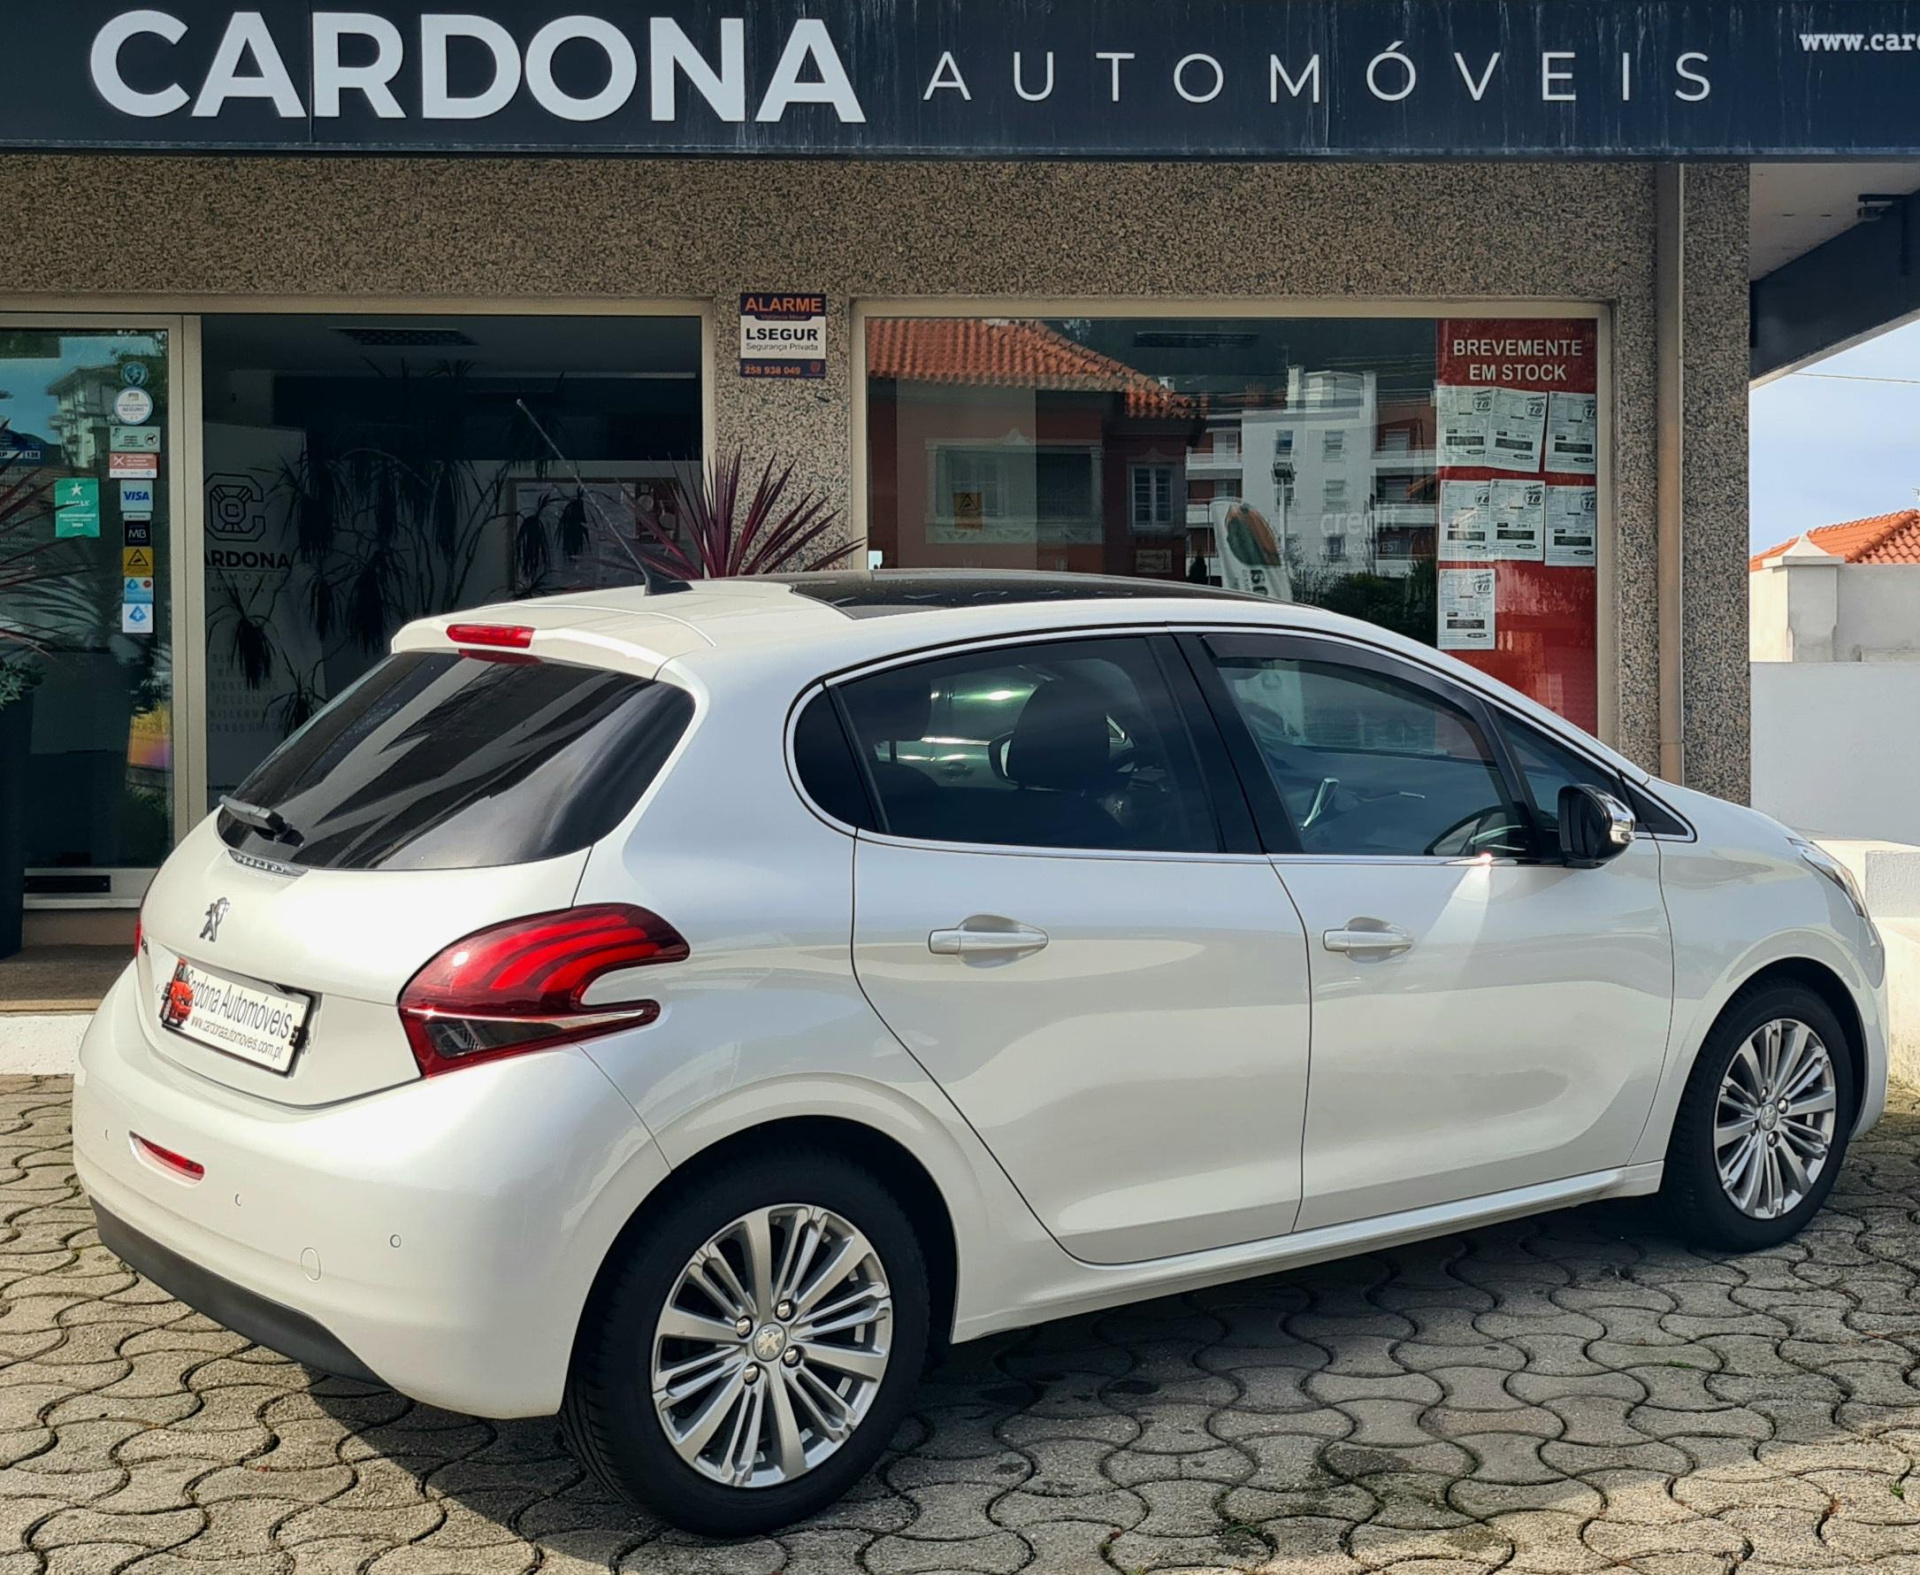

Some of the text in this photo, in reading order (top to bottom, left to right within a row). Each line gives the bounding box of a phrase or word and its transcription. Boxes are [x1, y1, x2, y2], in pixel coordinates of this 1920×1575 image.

[1799, 33, 1920, 52] www.car
[90, 9, 1712, 124] CARDONA AUTOMÓVEIS
[745, 297, 822, 313] ALARME
[746, 327, 819, 341] LSEGUR
[746, 342, 819, 352] Segurança Privada
[1453, 339, 1583, 357] BREVEMENTE
[1469, 364, 1567, 381] EM STOCK
[123, 491, 150, 501] VISA
[217, 984, 293, 1039] Automóveis
